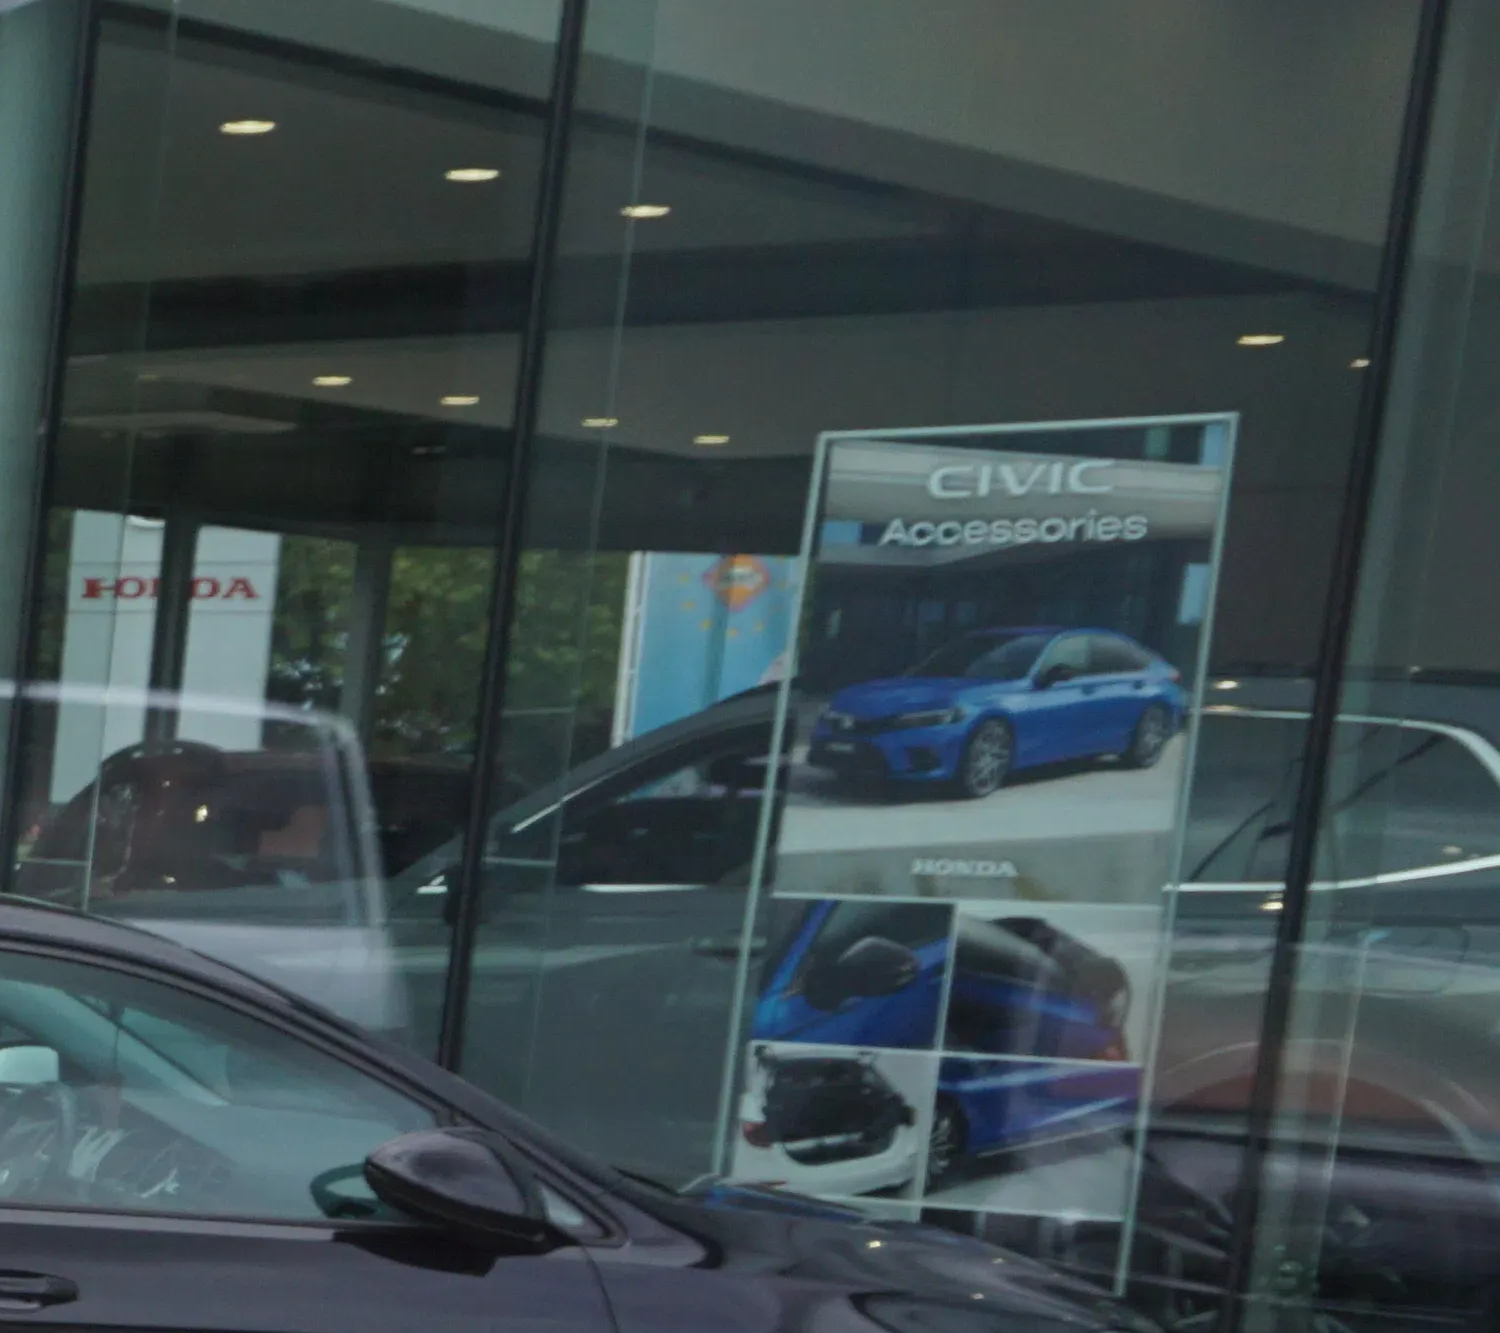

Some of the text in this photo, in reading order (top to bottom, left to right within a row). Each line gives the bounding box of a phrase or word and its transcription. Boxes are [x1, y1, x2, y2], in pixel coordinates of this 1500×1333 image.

[927, 459, 1117, 499] CIVIC
[879, 508, 1148, 547] Accessories
[81, 577, 261, 600] HODA
[911, 858, 1018, 878] HONDA
